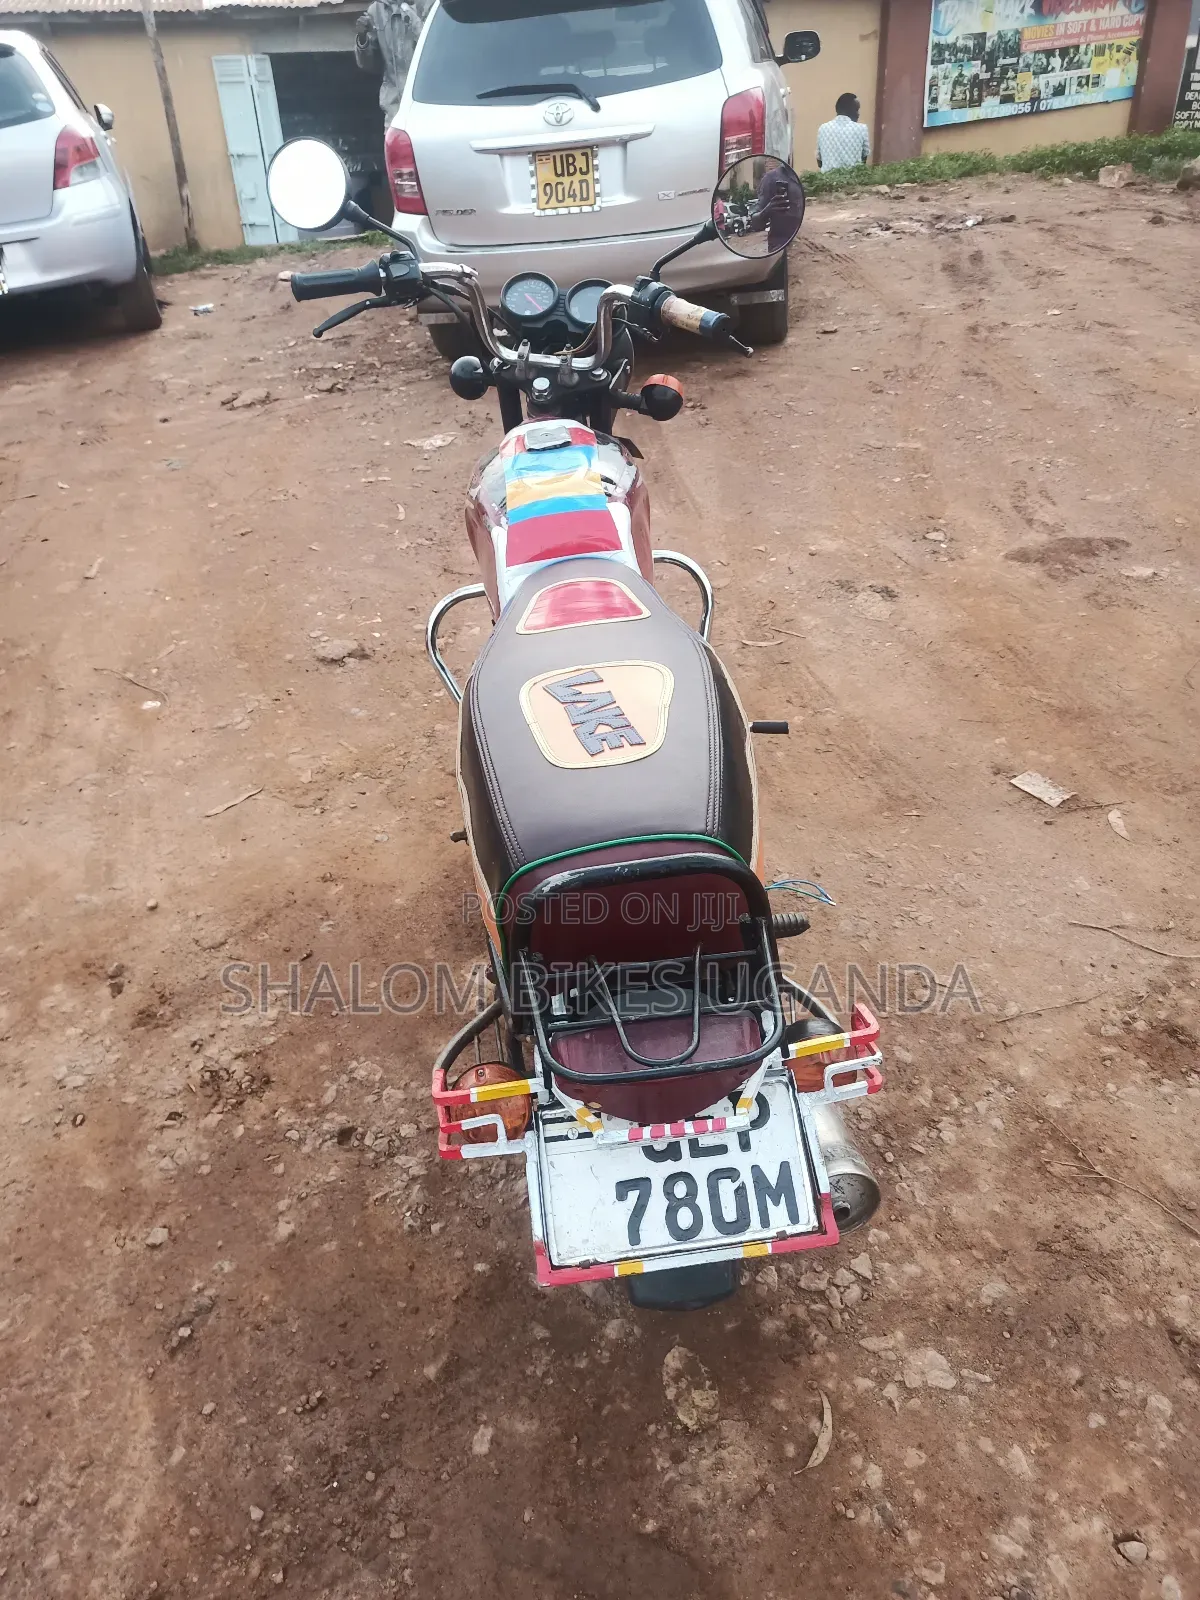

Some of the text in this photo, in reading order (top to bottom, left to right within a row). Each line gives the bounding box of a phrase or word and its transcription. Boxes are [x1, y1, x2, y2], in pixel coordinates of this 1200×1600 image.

[1023, 12, 1144, 40] MOVIES IN SOFT & HARD COPY
[1022, 40, 1052, 51] Computer
[552, 152, 590, 177] UBJ
[543, 179, 590, 205] 904D
[542, 670, 646, 758] WAKE
[615, 1161, 800, 1247] 780M
